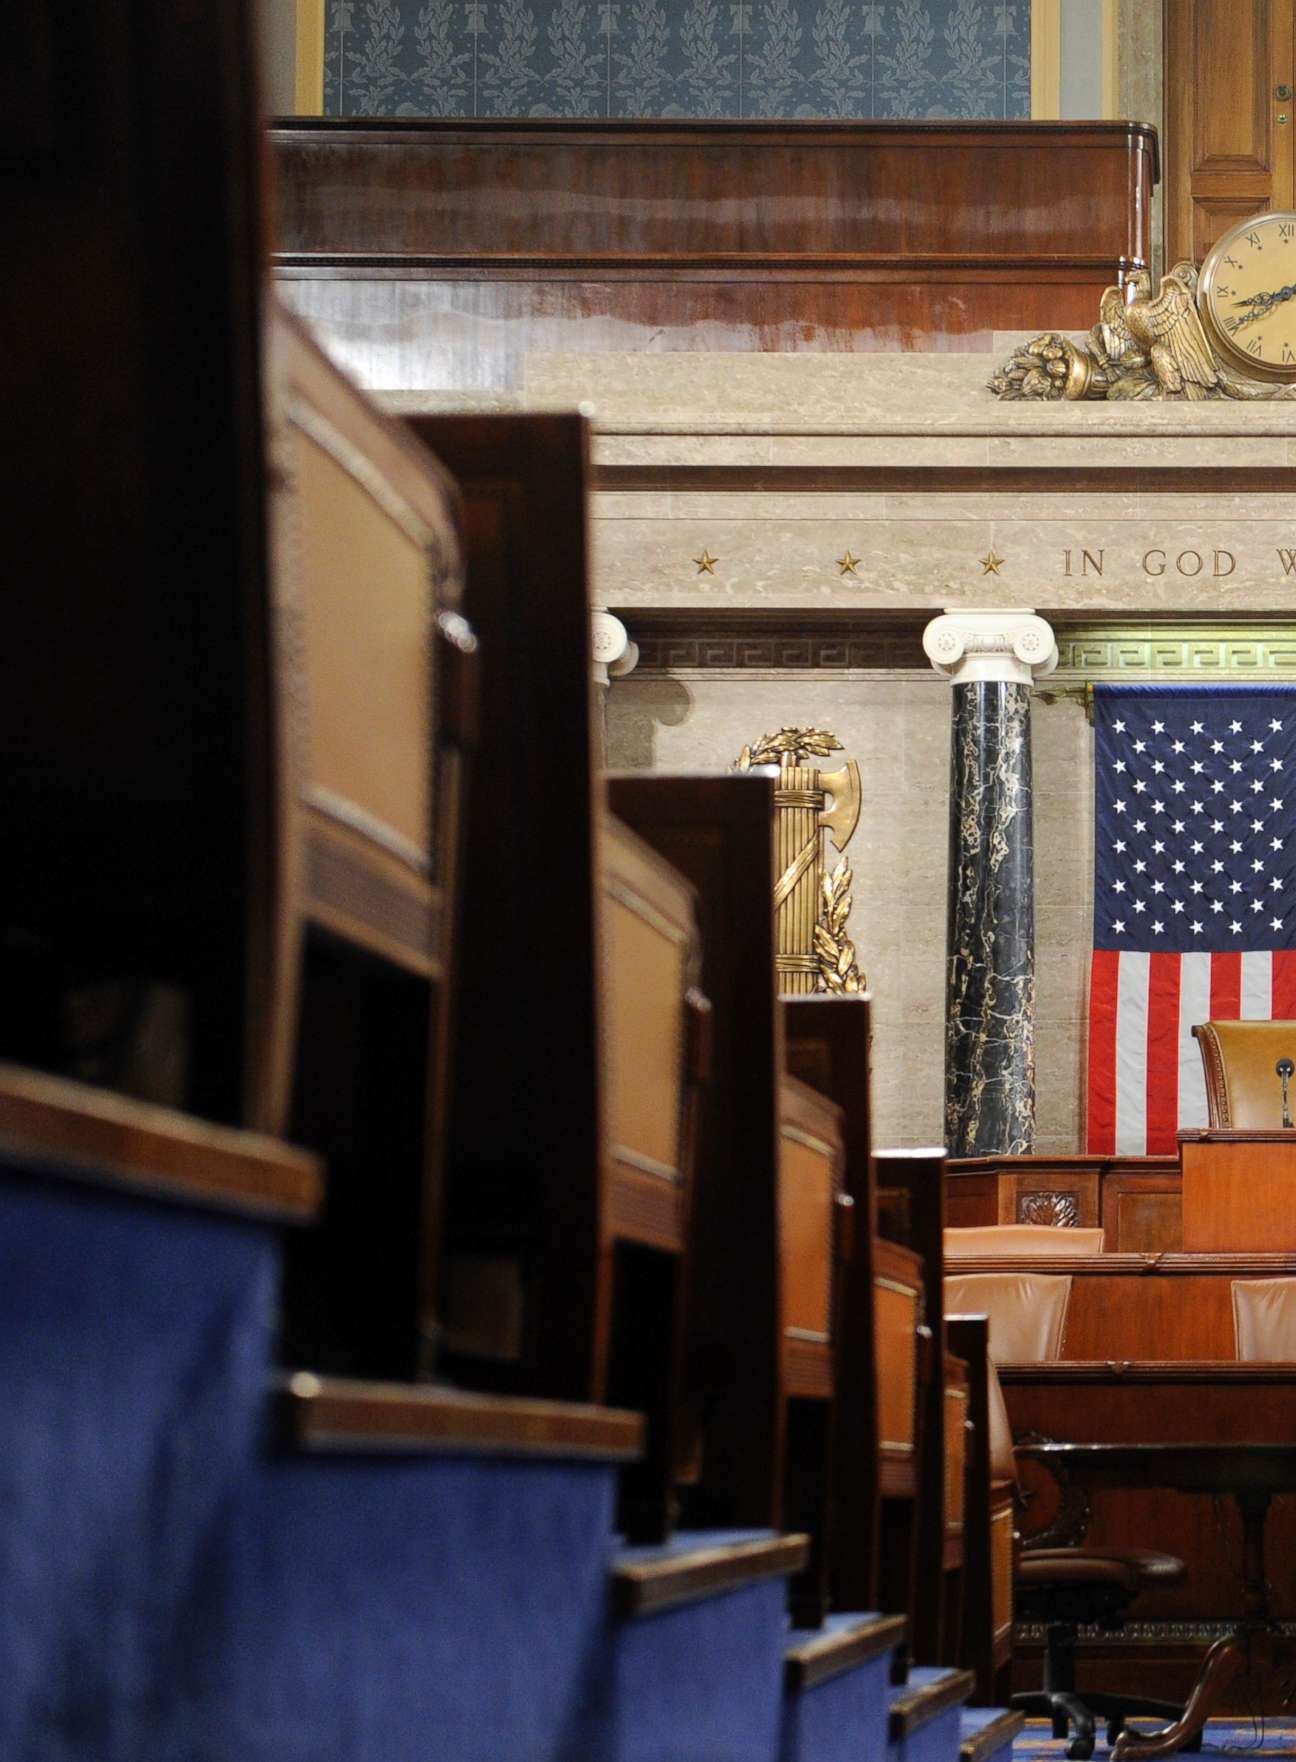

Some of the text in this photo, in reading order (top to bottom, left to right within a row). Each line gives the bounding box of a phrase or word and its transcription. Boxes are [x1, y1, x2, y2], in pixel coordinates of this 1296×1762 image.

[1279, 224, 1294, 237] XII
[1245, 232, 1261, 248] XI
[1225, 256, 1238, 268] X
[1217, 286, 1229, 297] IX
[1246, 339, 1262, 357] VII
[1282, 349, 1296, 361] VI
[1063, 549, 1105, 577] IN
[1142, 549, 1237, 577] GOD
